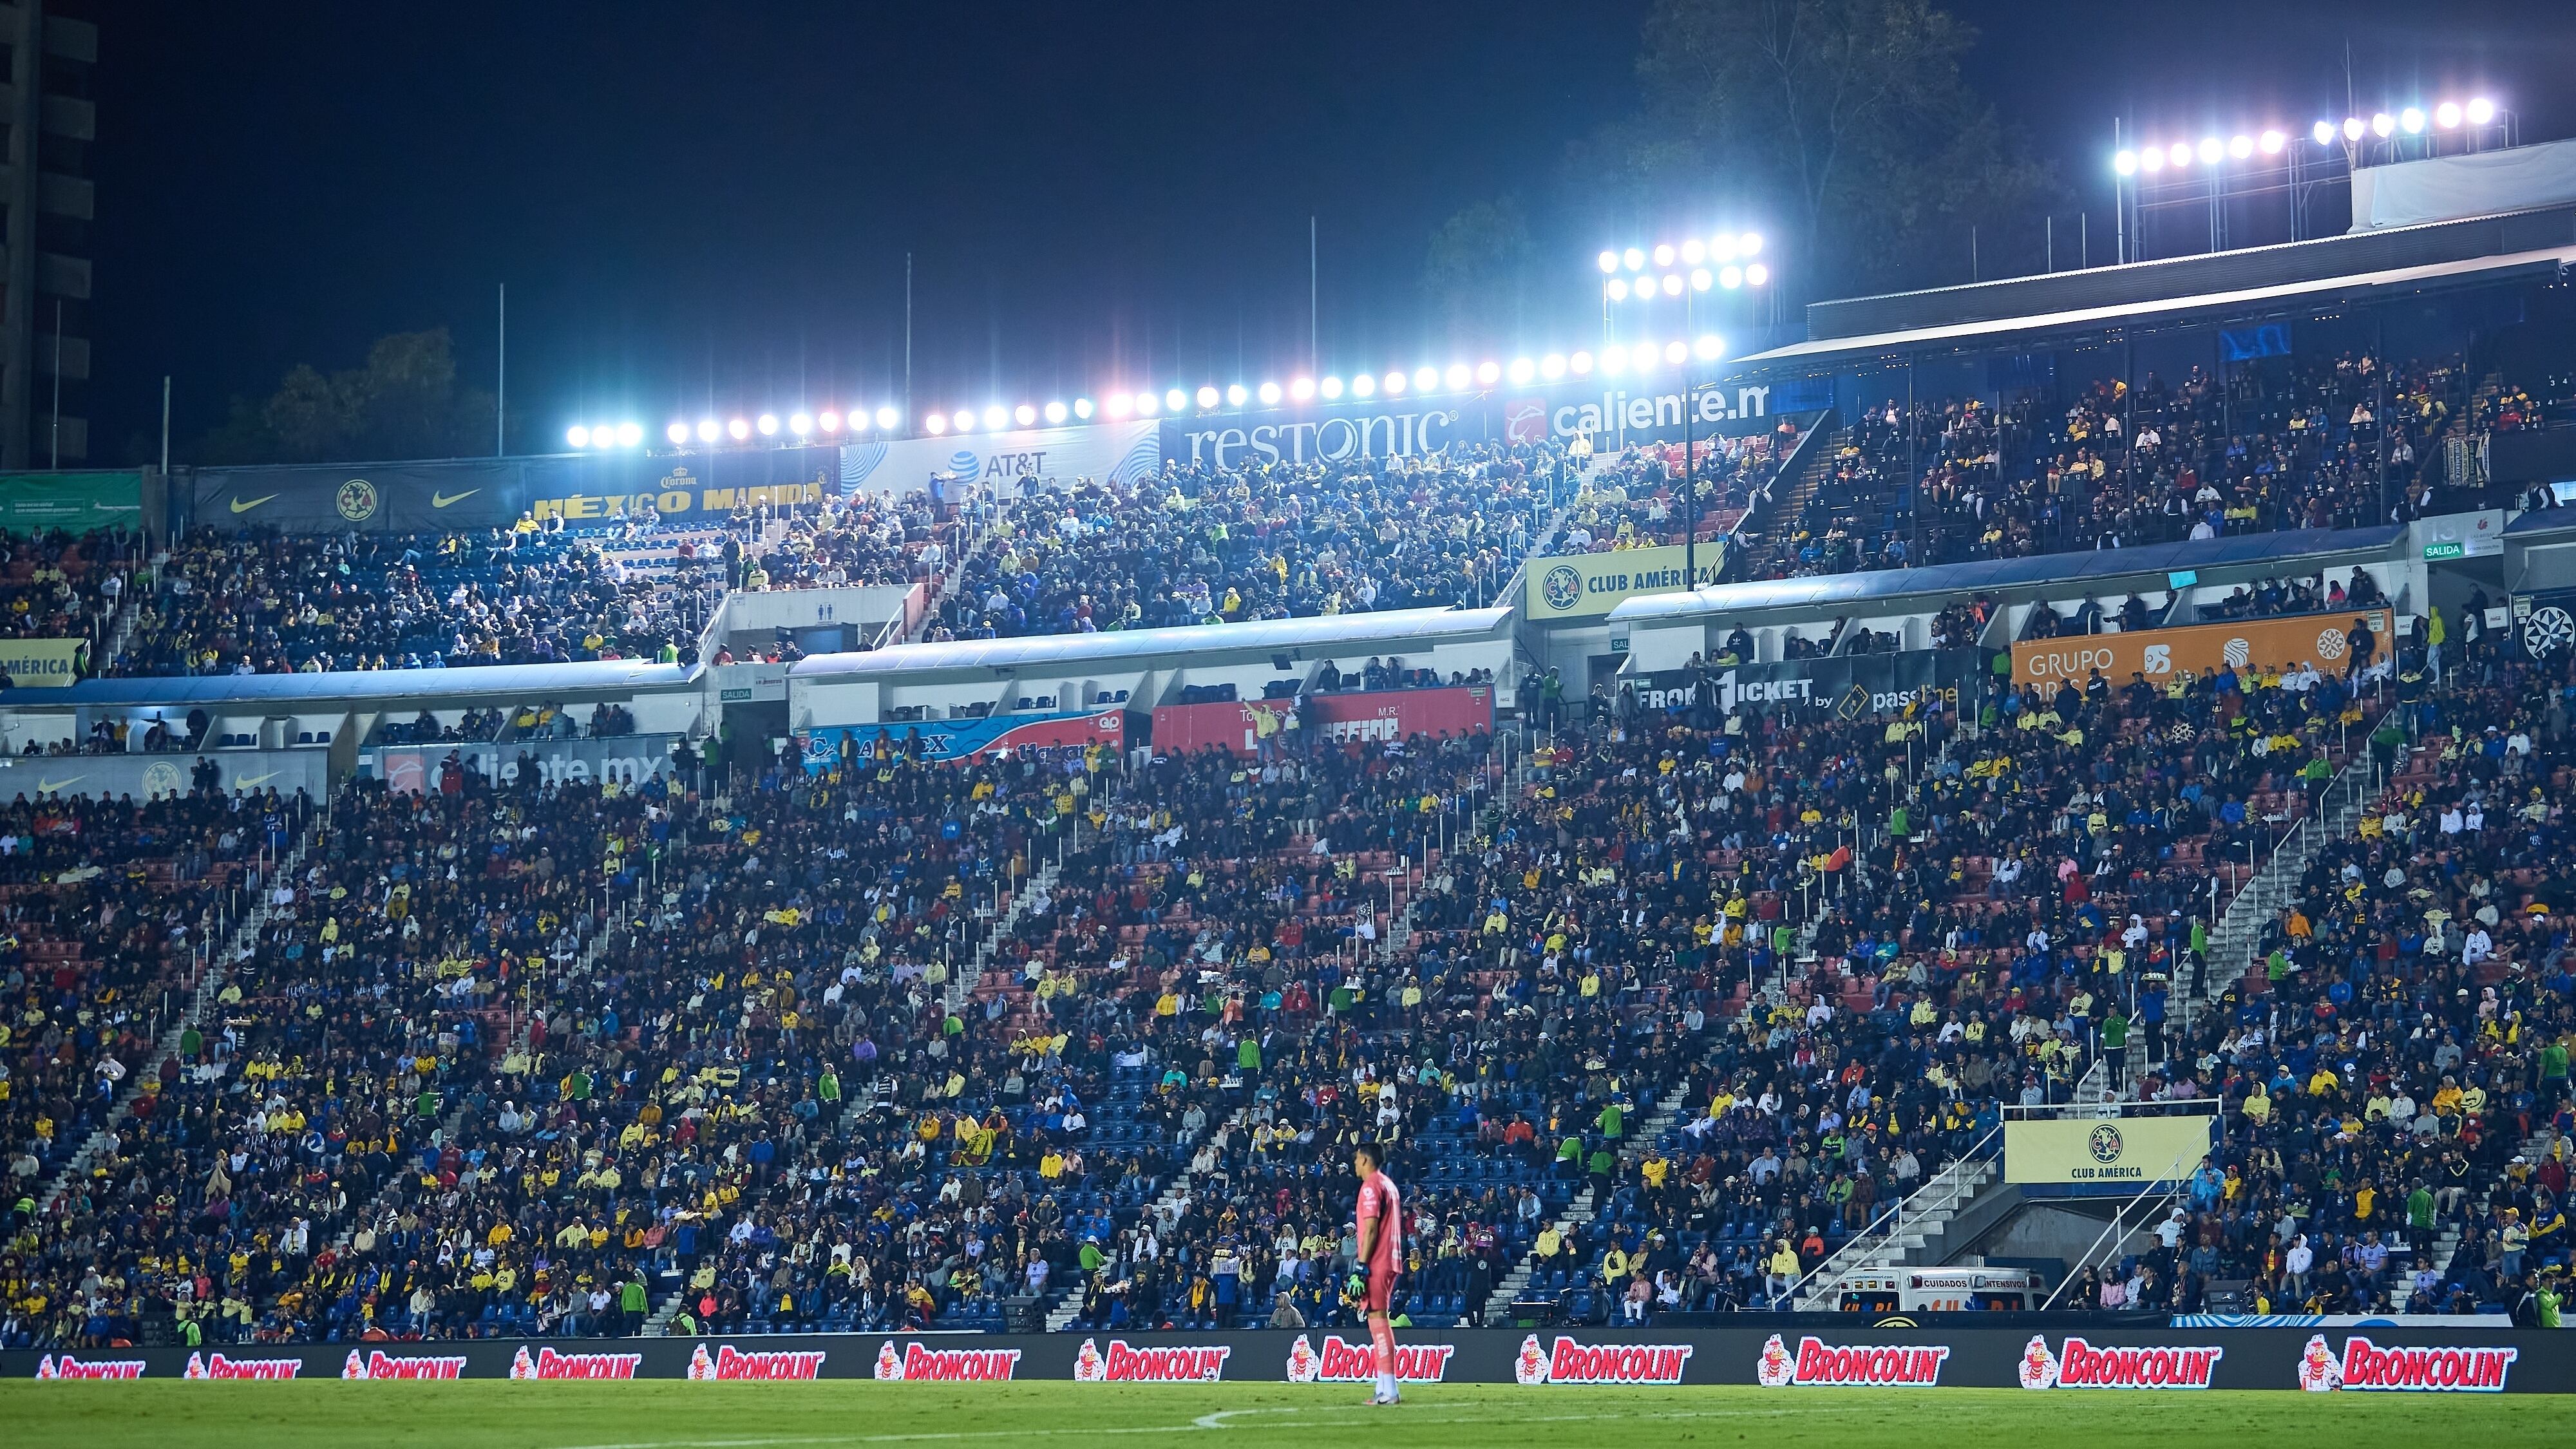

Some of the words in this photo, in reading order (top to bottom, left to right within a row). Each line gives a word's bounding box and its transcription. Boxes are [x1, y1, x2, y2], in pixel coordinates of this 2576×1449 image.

[985, 451, 1047, 478] AT&T
[660, 476, 697, 489] Corona
[534, 491, 692, 521] MÉXICO
[2426, 545, 2460, 556] SALIDA
[1588, 574, 1628, 593] CLUB
[1633, 566, 1710, 590] AMÉRIA
[2029, 648, 2114, 677] GRUPO
[722, 690, 750, 699] SALIDA
[1815, 697, 1833, 708] by
[1873, 684, 1957, 713] passlne
[1378, 706, 1399, 717] M.R.
[2072, 1168, 2095, 1179] CLUB
[2098, 1165, 2142, 1178] AMÉRICA
[1924, 1279, 1967, 1288] CUIDADOS
[1984, 1280, 2027, 1288] INTENSIVOS
[61, 1358, 140, 1379] BRONCOLIN
[210, 1356, 296, 1379] BRONCOLIN
[370, 1356, 458, 1379] BRONCOLIN
[539, 1352, 633, 1379] BRONCOLIN
[718, 1350, 817, 1379] BRONCOLIN
[905, 1347, 1012, 1380] BRONCOLIN
[1108, 1345, 1221, 1380] BRONCOLIN
[1322, 1340, 1444, 1378] BRONOLIN
[1553, 1341, 1682, 1379] BRONCOLIN
[1798, 1341, 1938, 1381] BRONCOLIN
[2062, 1343, 2210, 1384] BRONCOLIN
[2345, 1342, 2504, 1385] BRONCOLIN
